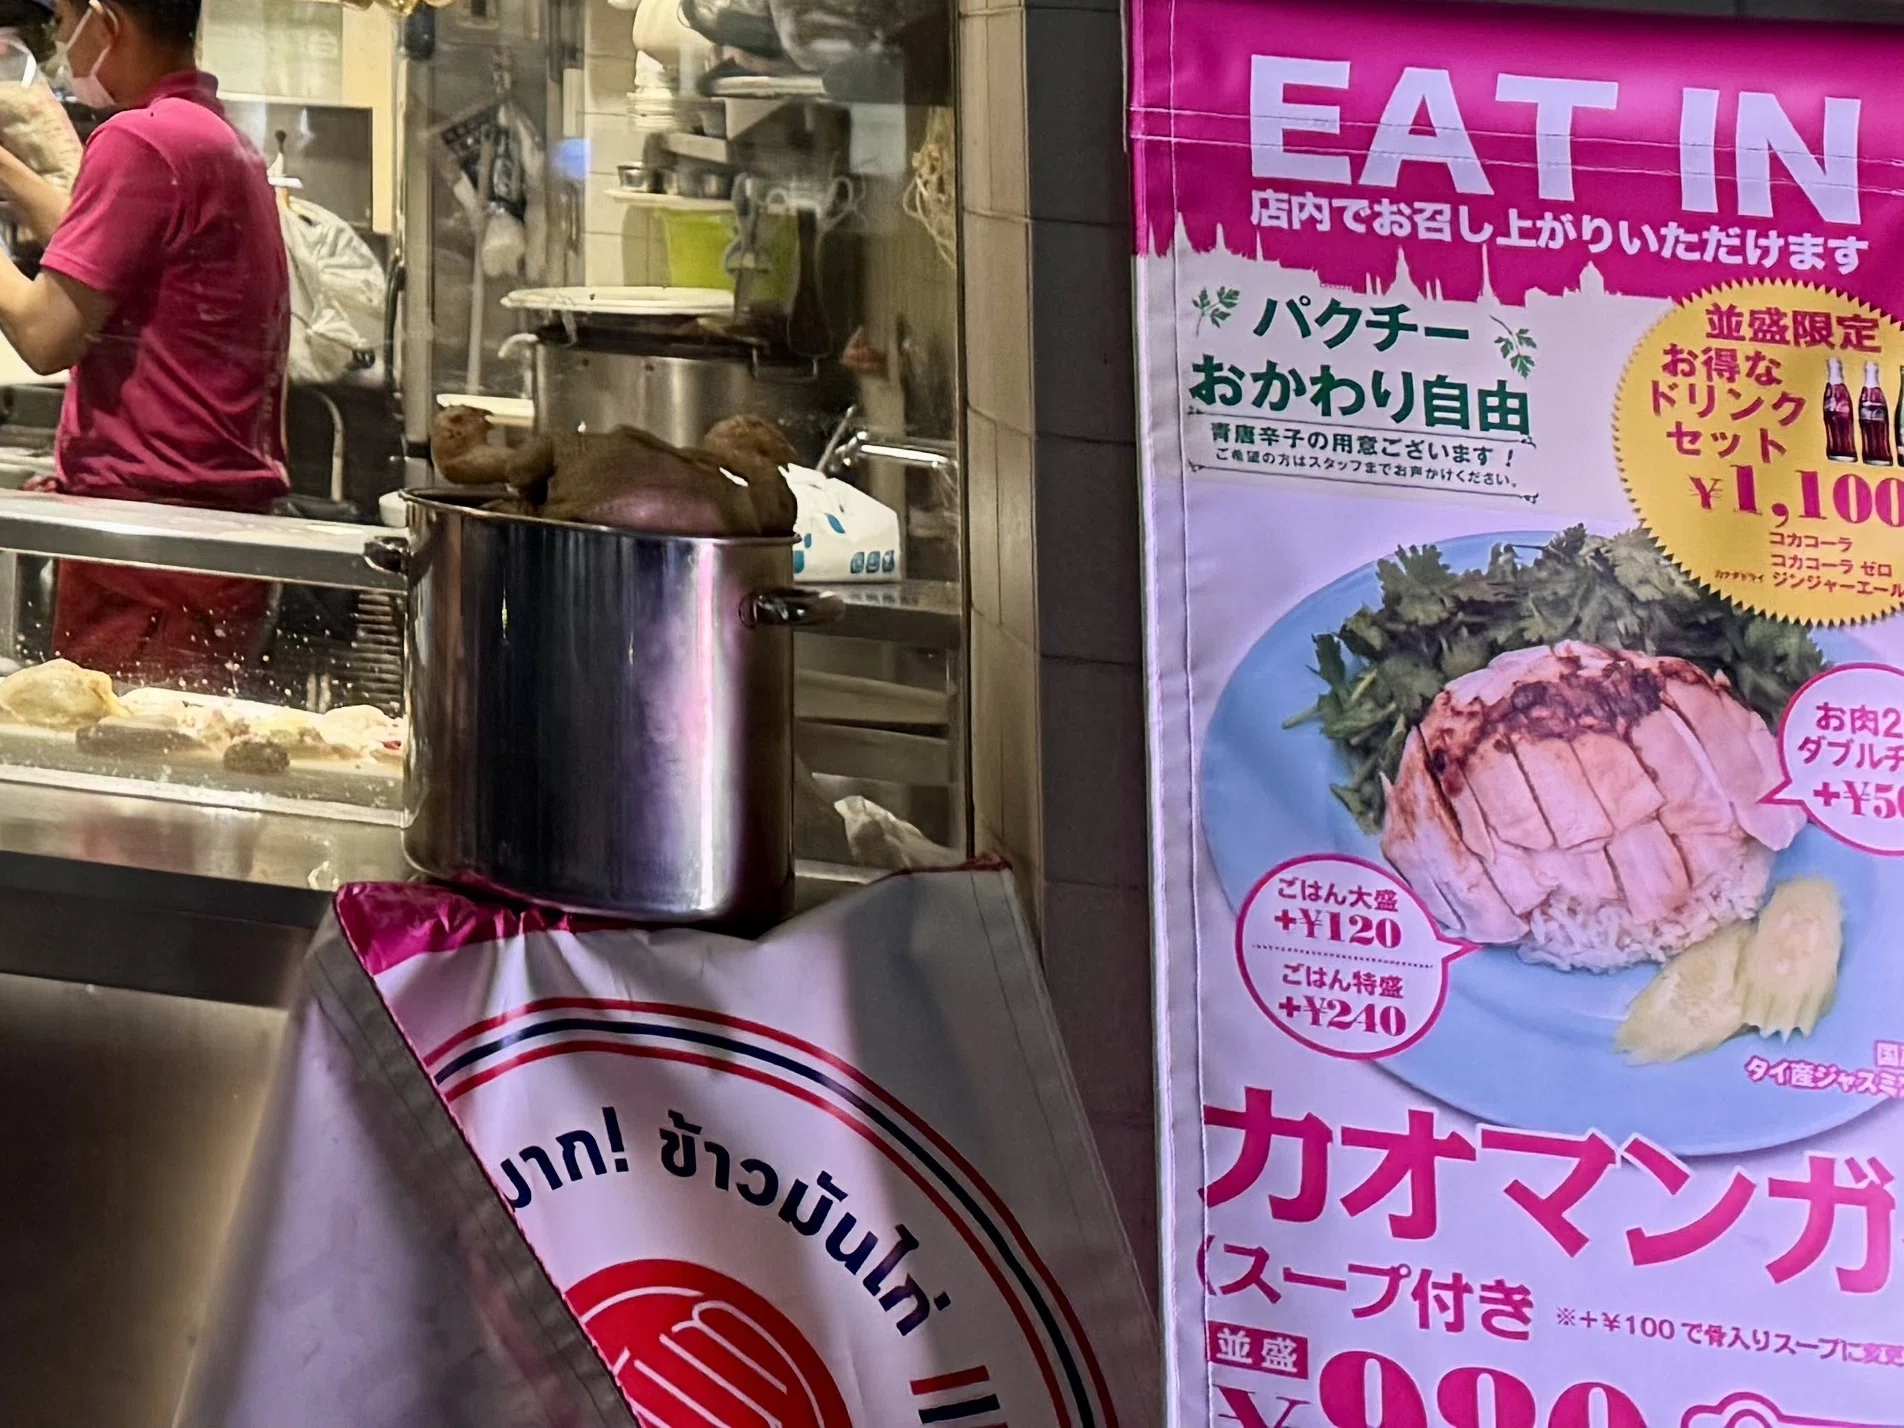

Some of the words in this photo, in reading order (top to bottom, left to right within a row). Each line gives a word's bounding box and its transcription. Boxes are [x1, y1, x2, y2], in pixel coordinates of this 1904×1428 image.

[1248, 54, 1620, 202] EAT
[1679, 86, 1863, 226] IN
[1250, 188, 1869, 275] 店内でお召し上がりいただけます
[1253, 294, 1471, 352] パクチー
[1704, 302, 1884, 357] 並盛限定
[1659, 345, 1782, 385] お得な
[1188, 353, 1531, 438] おかわり自由
[1650, 379, 1809, 427] ドリンク
[1665, 424, 1790, 465] セット
[1769, 531, 1854, 553] コカコーラ
[1770, 553, 1854, 575] コカコーラ
[1860, 560, 1893, 578] ゼロ
[1276, 874, 1401, 914] ごはん大盛
[1273, 906, 1403, 950] +¥120
[1280, 962, 1406, 1000] ごはん特盛
[1276, 994, 1408, 1039] +¥240
[658, 1109, 953, 1337] ข้าวมันไก่
[1217, 1327, 1299, 1374] 並盛
